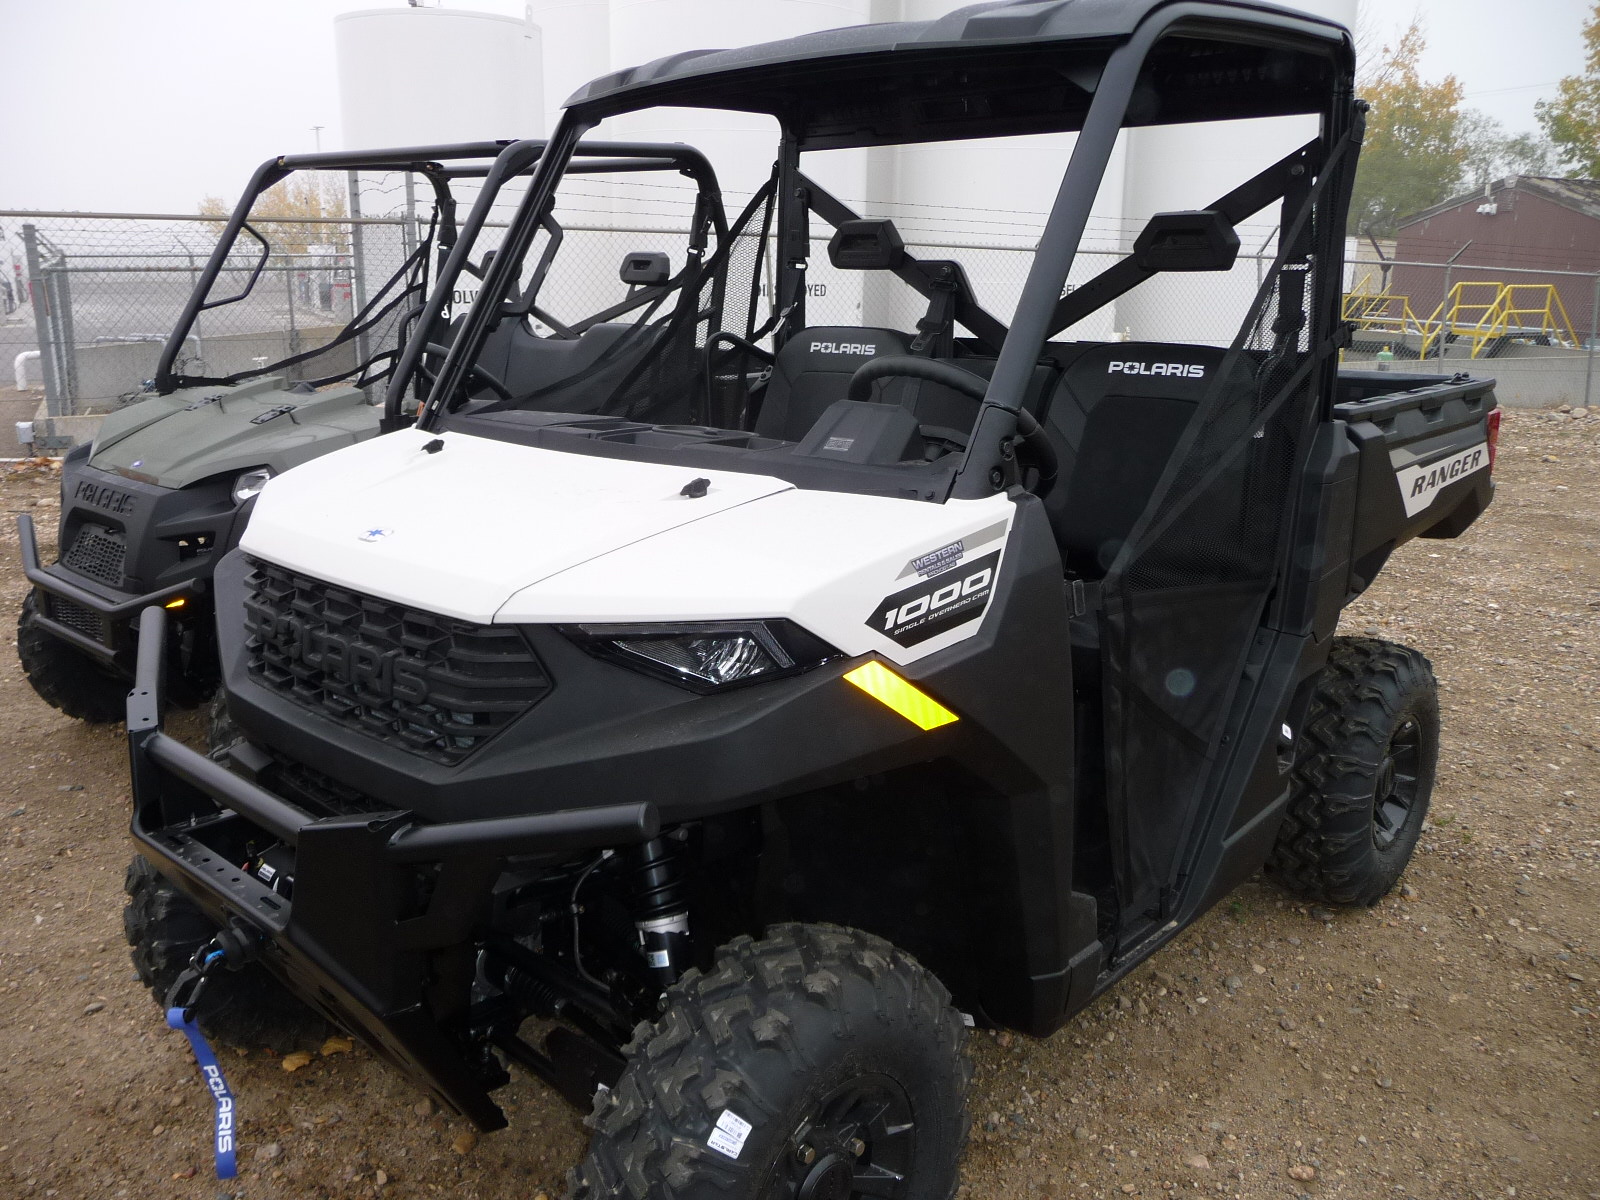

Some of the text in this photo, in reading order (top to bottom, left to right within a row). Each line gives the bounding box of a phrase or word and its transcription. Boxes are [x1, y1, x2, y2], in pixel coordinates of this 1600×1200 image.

[805, 284, 827, 297] YED
[810, 341, 876, 356] POLARIS
[1107, 361, 1205, 378] POLARIS
[1410, 449, 1482, 499] RANGER
[75, 480, 138, 517] POLARIS
[912, 541, 964, 570] WESTERN
[884, 567, 992, 631] 1000
[894, 589, 990, 636] SINGLE OVERHEAD CAM
[246, 600, 428, 705] POLARIS
[203, 1065, 232, 1153] POLARIS
